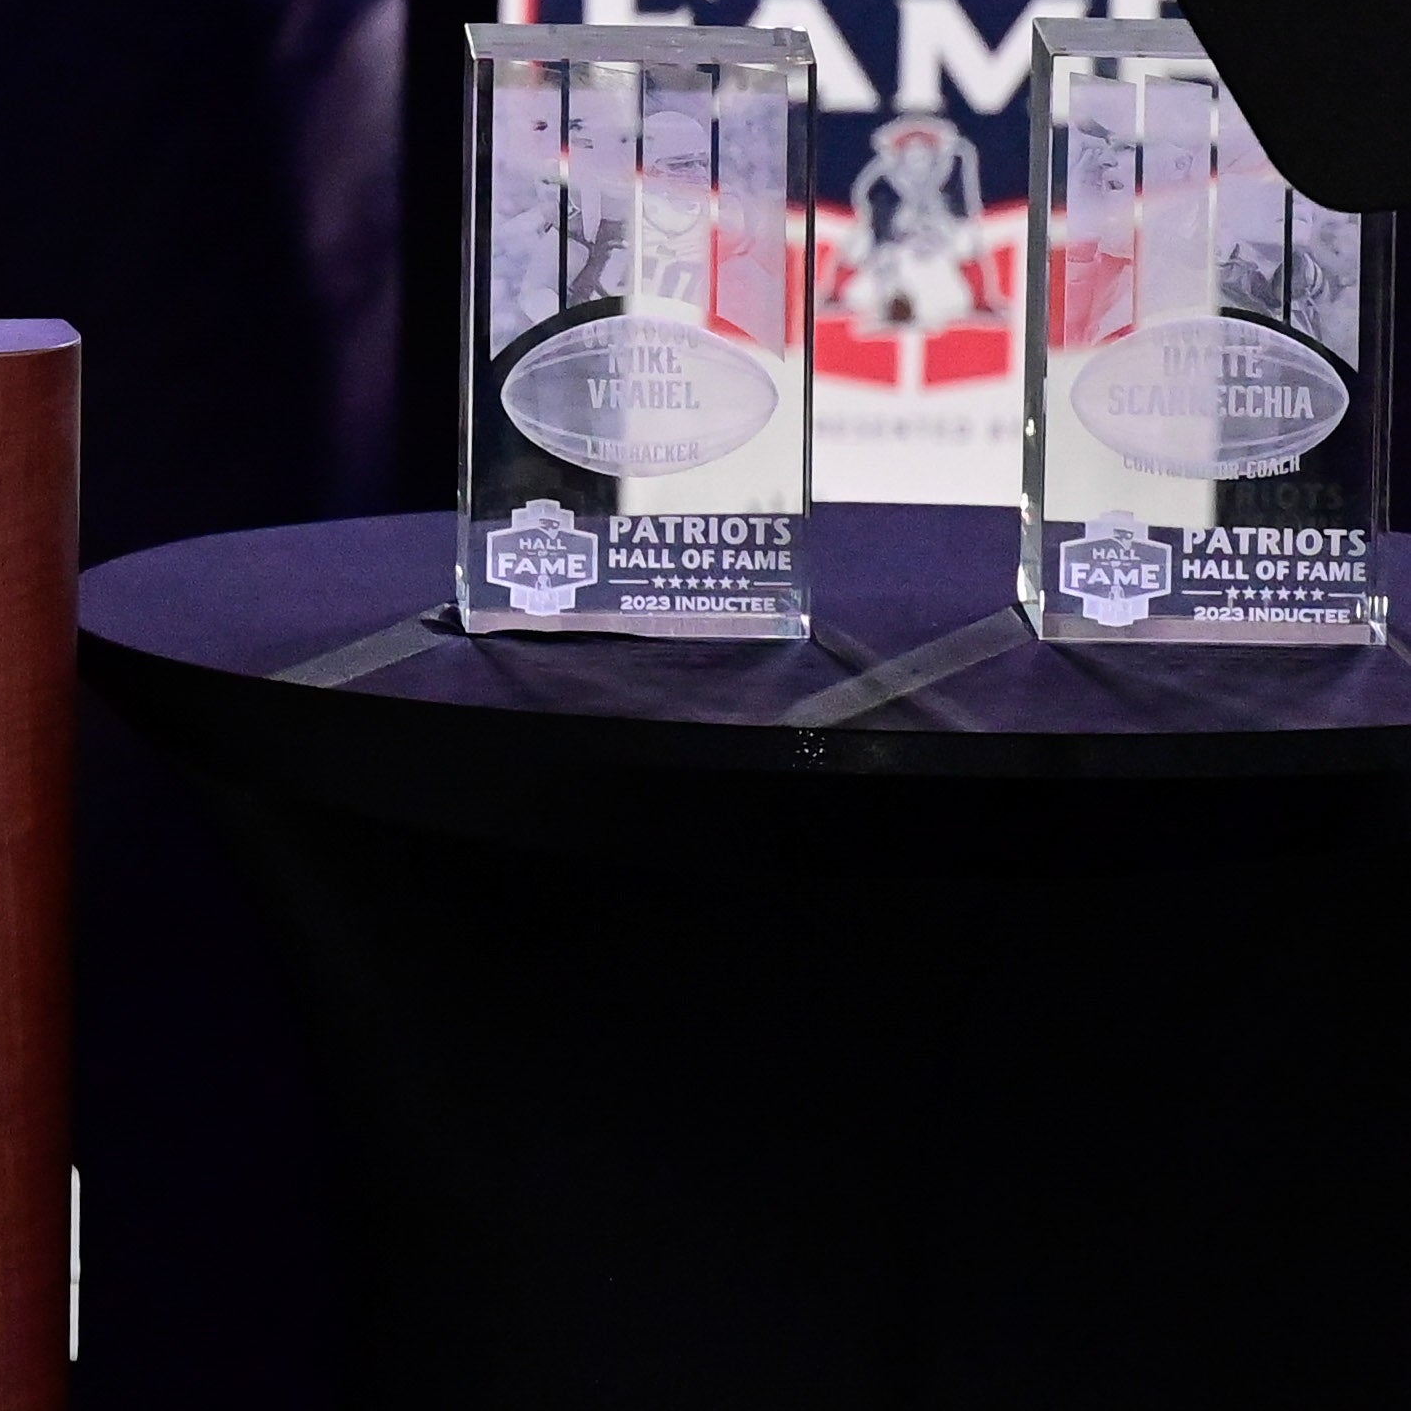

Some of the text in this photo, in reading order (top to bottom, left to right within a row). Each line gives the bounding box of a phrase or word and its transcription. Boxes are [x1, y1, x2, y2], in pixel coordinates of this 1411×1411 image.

[608, 515, 793, 546] PATRIOTS
[1182, 526, 1367, 557] PATRIOTS
[518, 537, 567, 551] HALL
[1091, 546, 1142, 561] HALL
[497, 552, 587, 579] FAME
[607, 547, 793, 572] HALL OF FAME
[1182, 558, 1367, 583] HALL OF FAME
[1069, 562, 1160, 589] FAME
[619, 594, 777, 612] 2023 INDUCTEE
[1193, 605, 1351, 624] 2023 INDUCTEE
